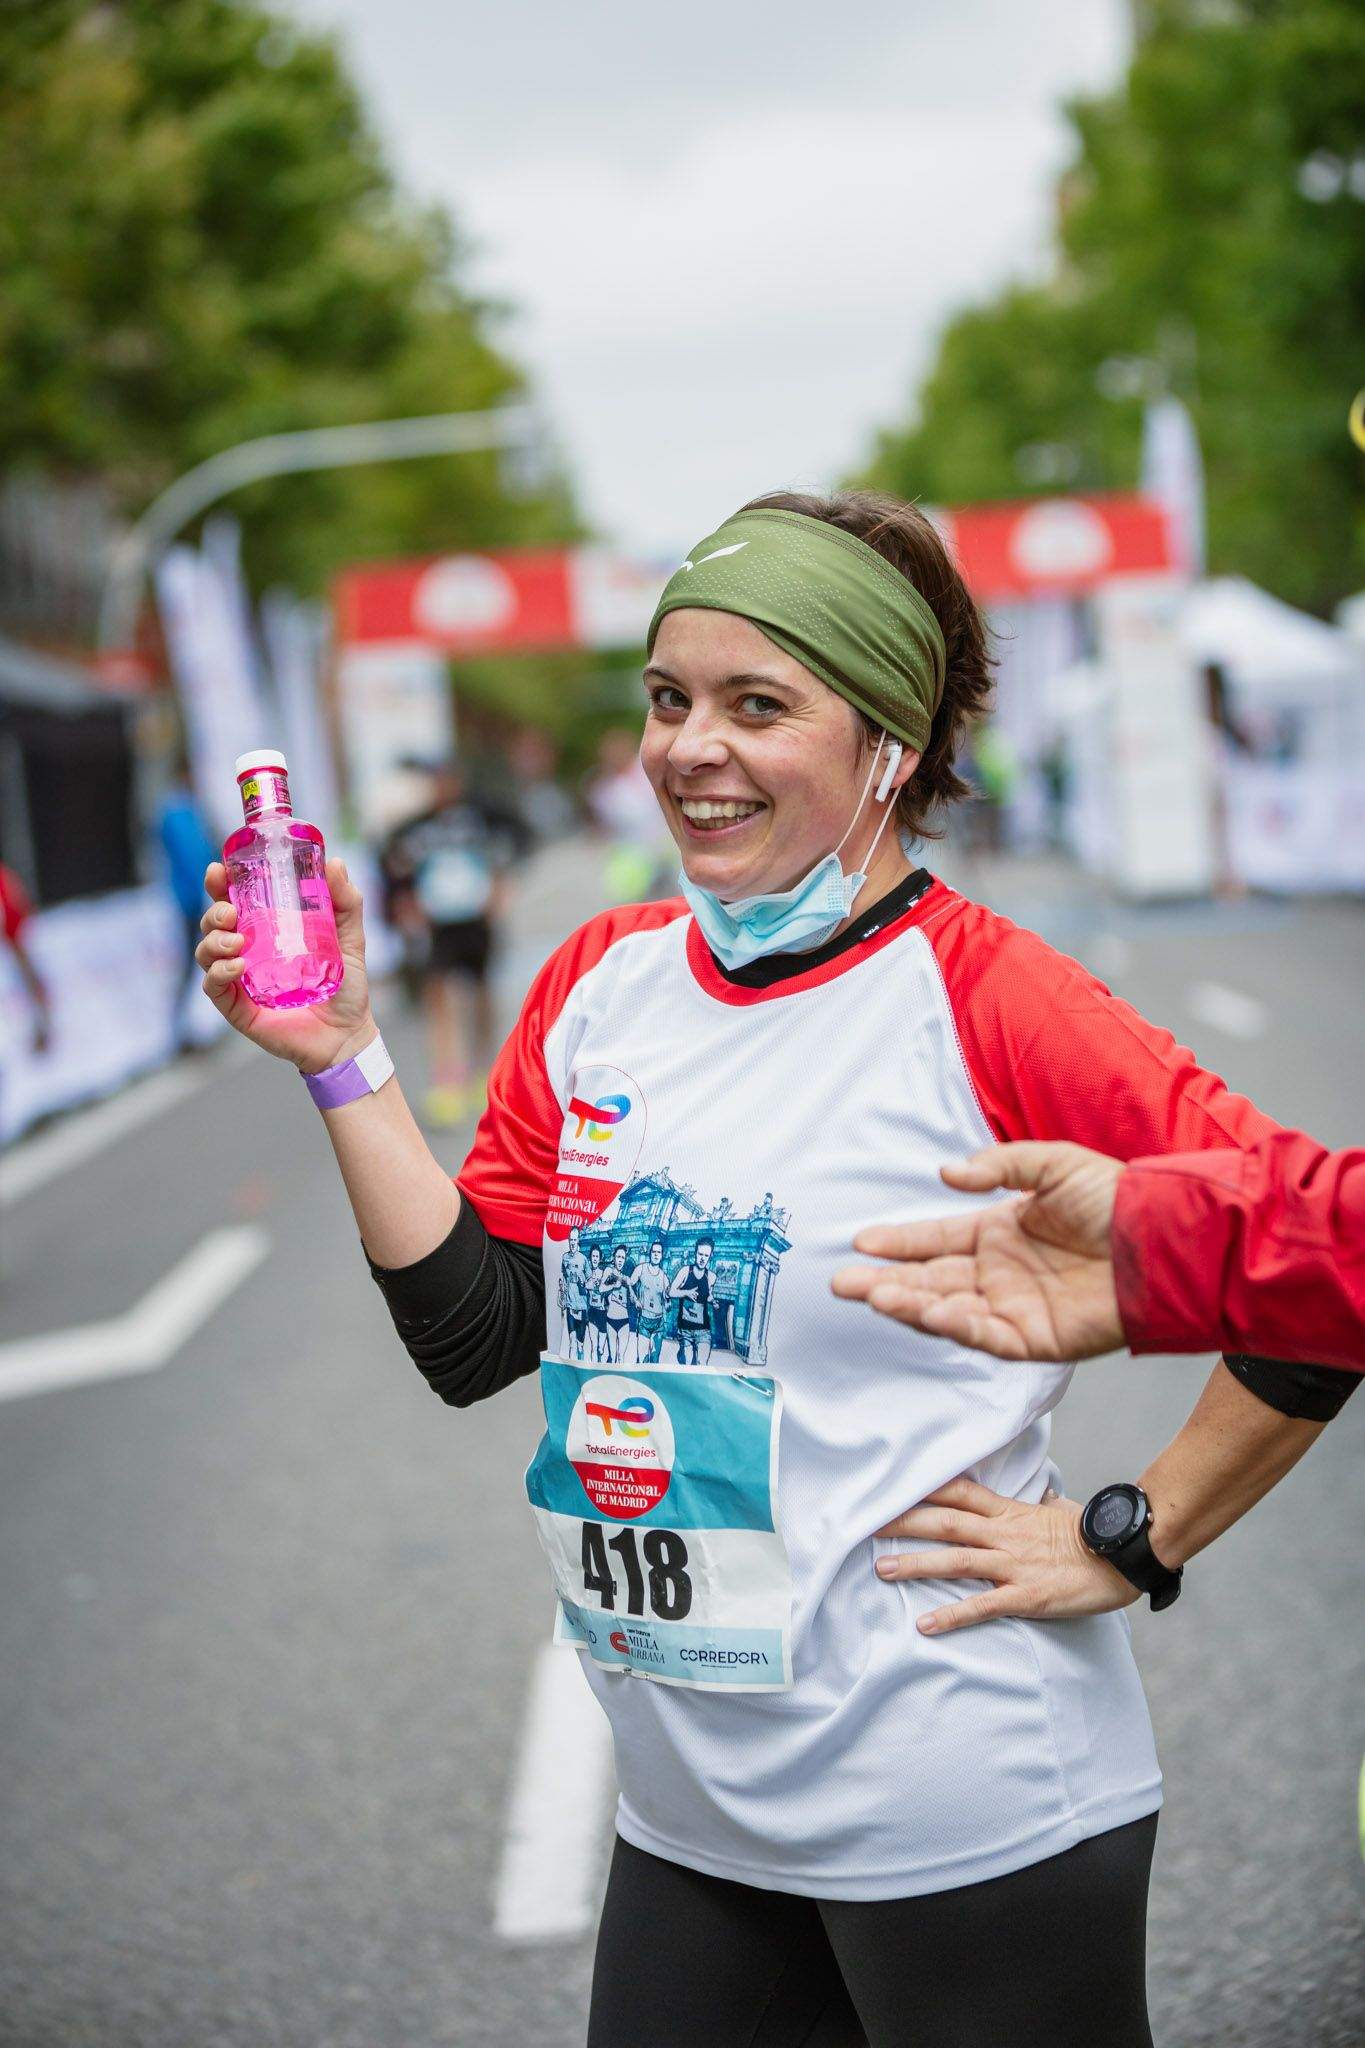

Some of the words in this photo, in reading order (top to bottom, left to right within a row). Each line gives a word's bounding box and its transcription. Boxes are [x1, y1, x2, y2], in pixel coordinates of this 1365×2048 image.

[586, 1444, 656, 1459] TotalEnergies
[604, 1469, 634, 1482] MILLA
[595, 1493, 608, 1504] DE
[609, 1496, 648, 1508] MADRID
[581, 1521, 692, 1621] 418
[628, 1635, 659, 1650] MILLA
